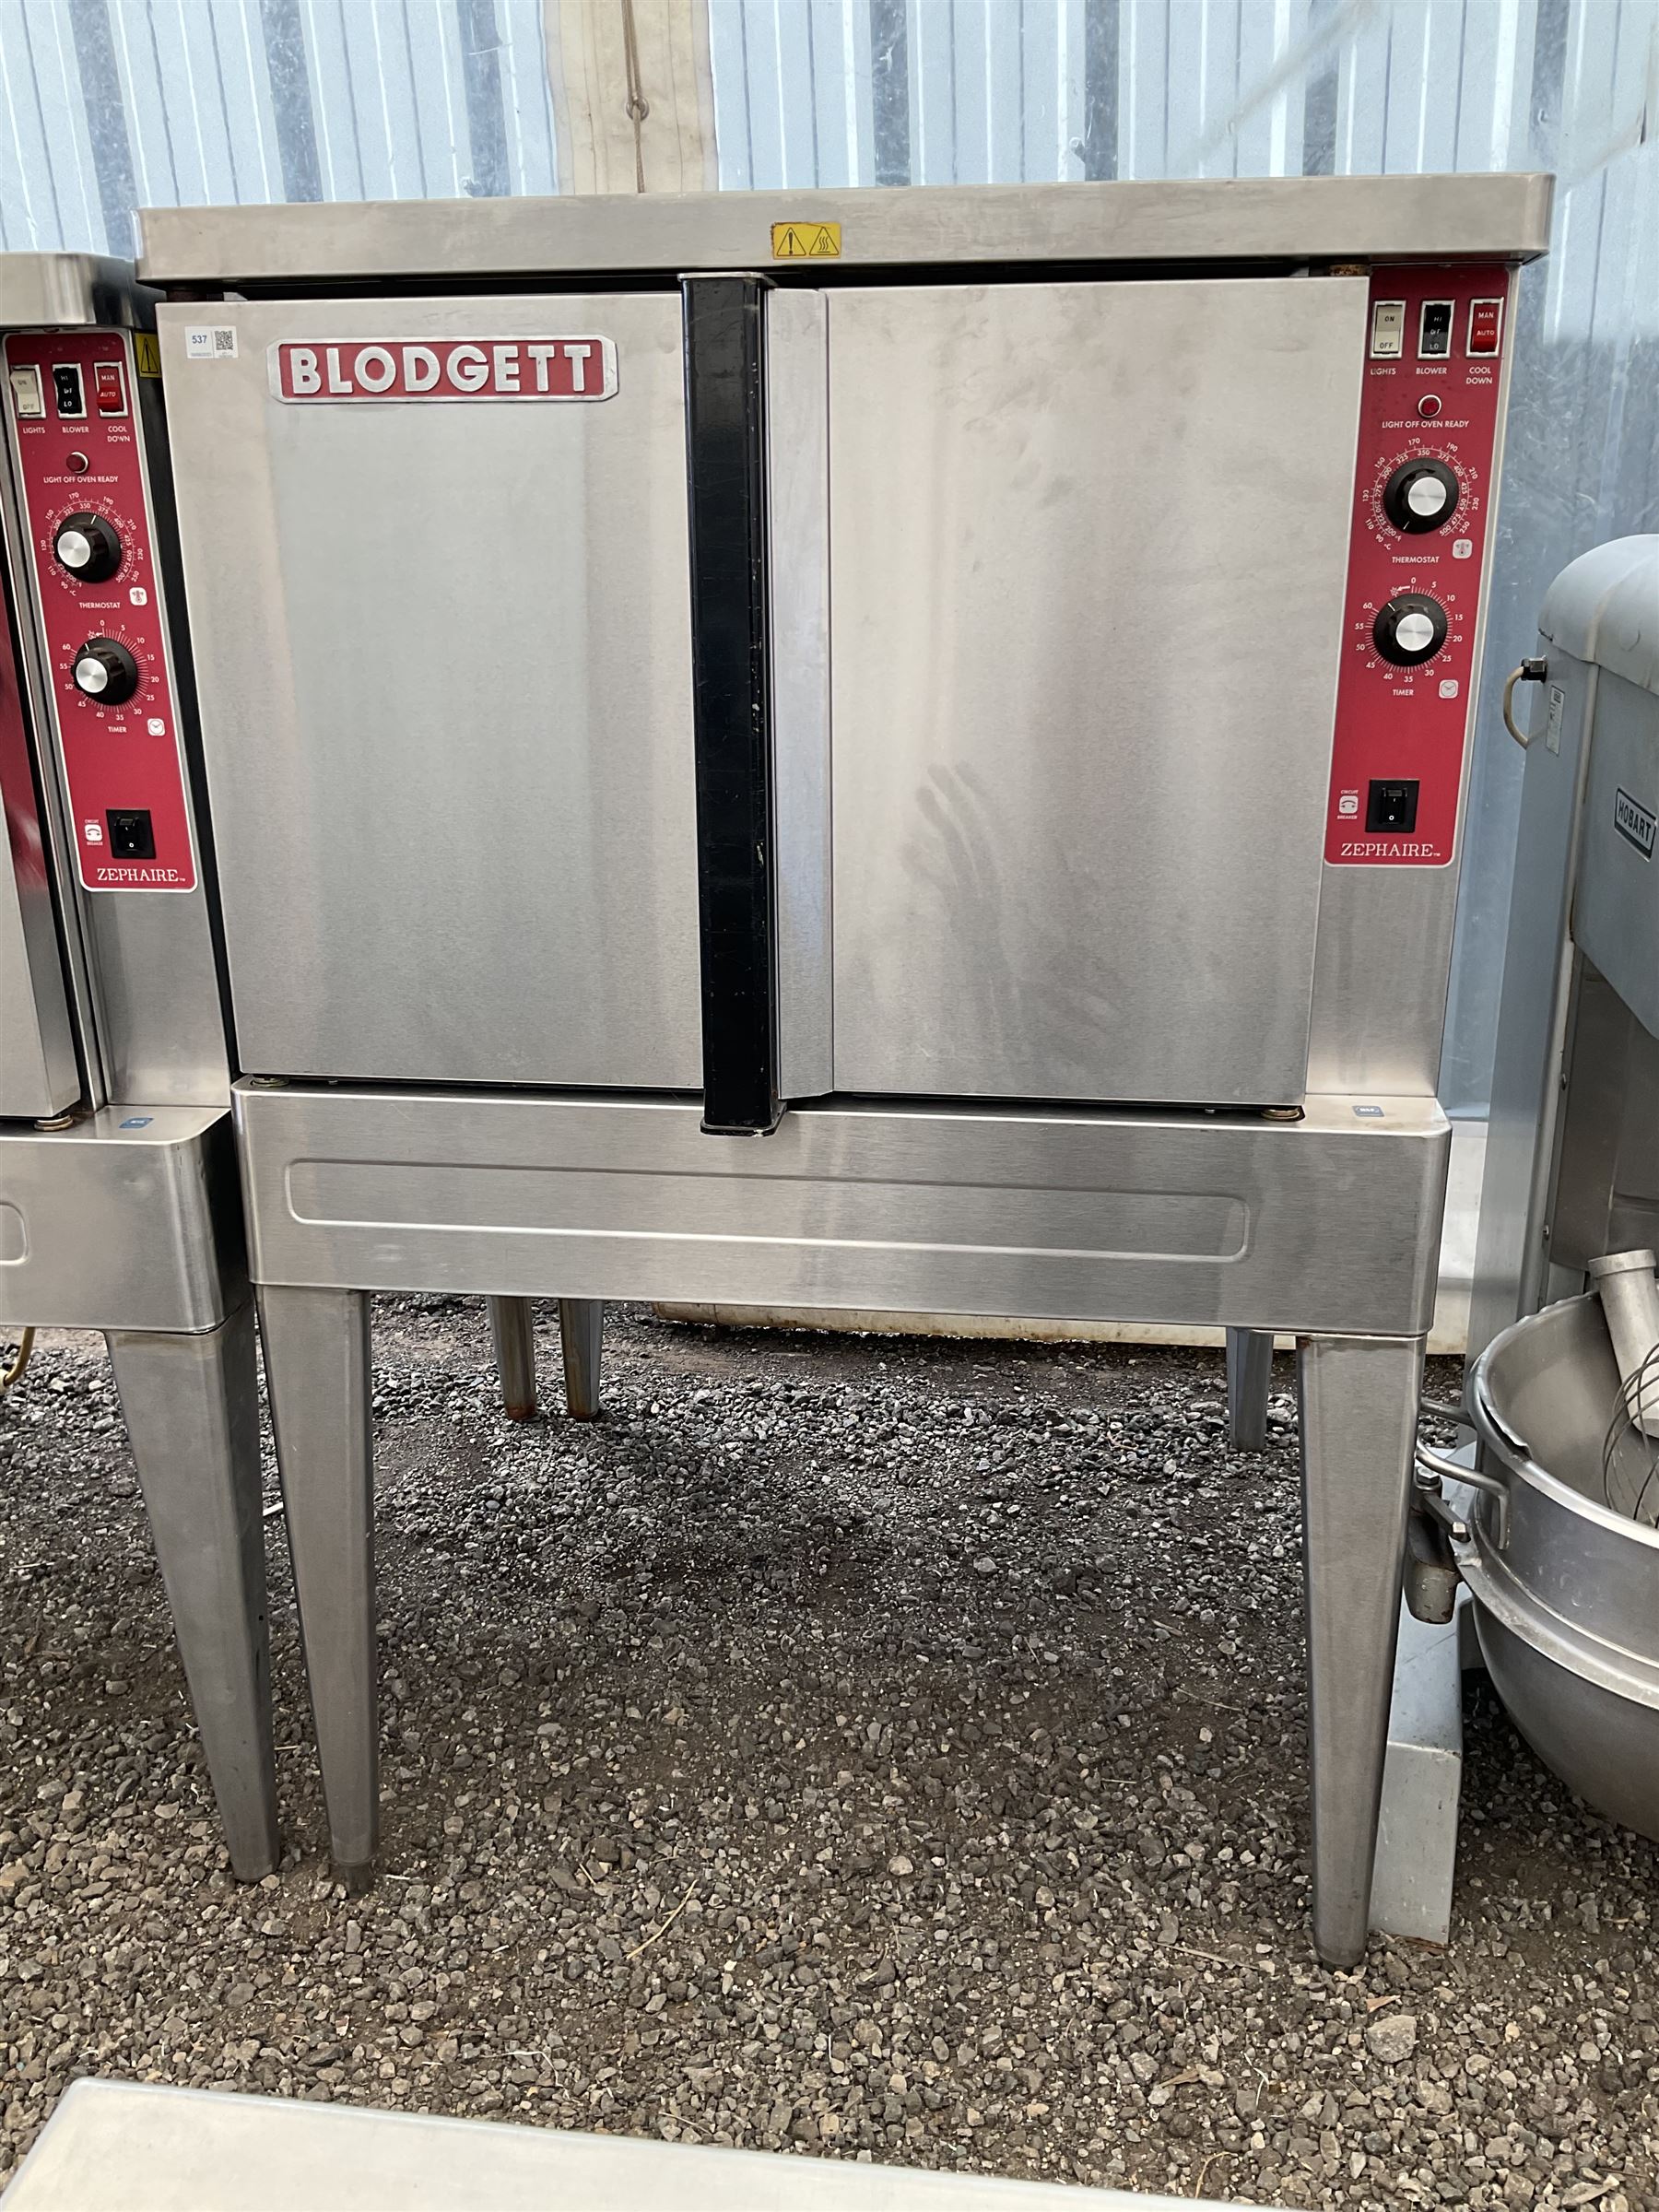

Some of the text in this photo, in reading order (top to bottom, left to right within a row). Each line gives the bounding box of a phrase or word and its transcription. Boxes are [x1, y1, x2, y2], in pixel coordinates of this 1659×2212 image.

[192, 335, 206, 344] 537
[289, 344, 592, 394] BLODGETT
[1408, 437, 1420, 445] 170
[1446, 441, 1458, 453] 190
[1395, 453, 1408, 465] 325
[1437, 452, 1450, 462] 375
[1382, 466, 1392, 479] 300
[1453, 465, 1464, 477] 400
[1468, 467, 1478, 479] 210
[103, 497, 113, 505] 190
[1459, 498, 1467, 512] 450
[64, 507, 74, 516] 325
[98, 506, 109, 514] 375
[114, 517, 124, 528] 400
[127, 519, 137, 530] 210
[1365, 518, 1374, 530] 110
[1451, 514, 1461, 526] 475
[1384, 525, 1396, 536] 200
[1439, 525, 1452, 536] 500
[1459, 521, 1470, 534] 250
[1375, 534, 1383, 543] 90
[115, 573, 125, 582] 500
[131, 571, 139, 582] 250
[1617, 799, 1652, 842] HOBART
[1341, 843, 1433, 856] ZEPHAIRE
[97, 868, 178, 881] ZEPHAIRE
